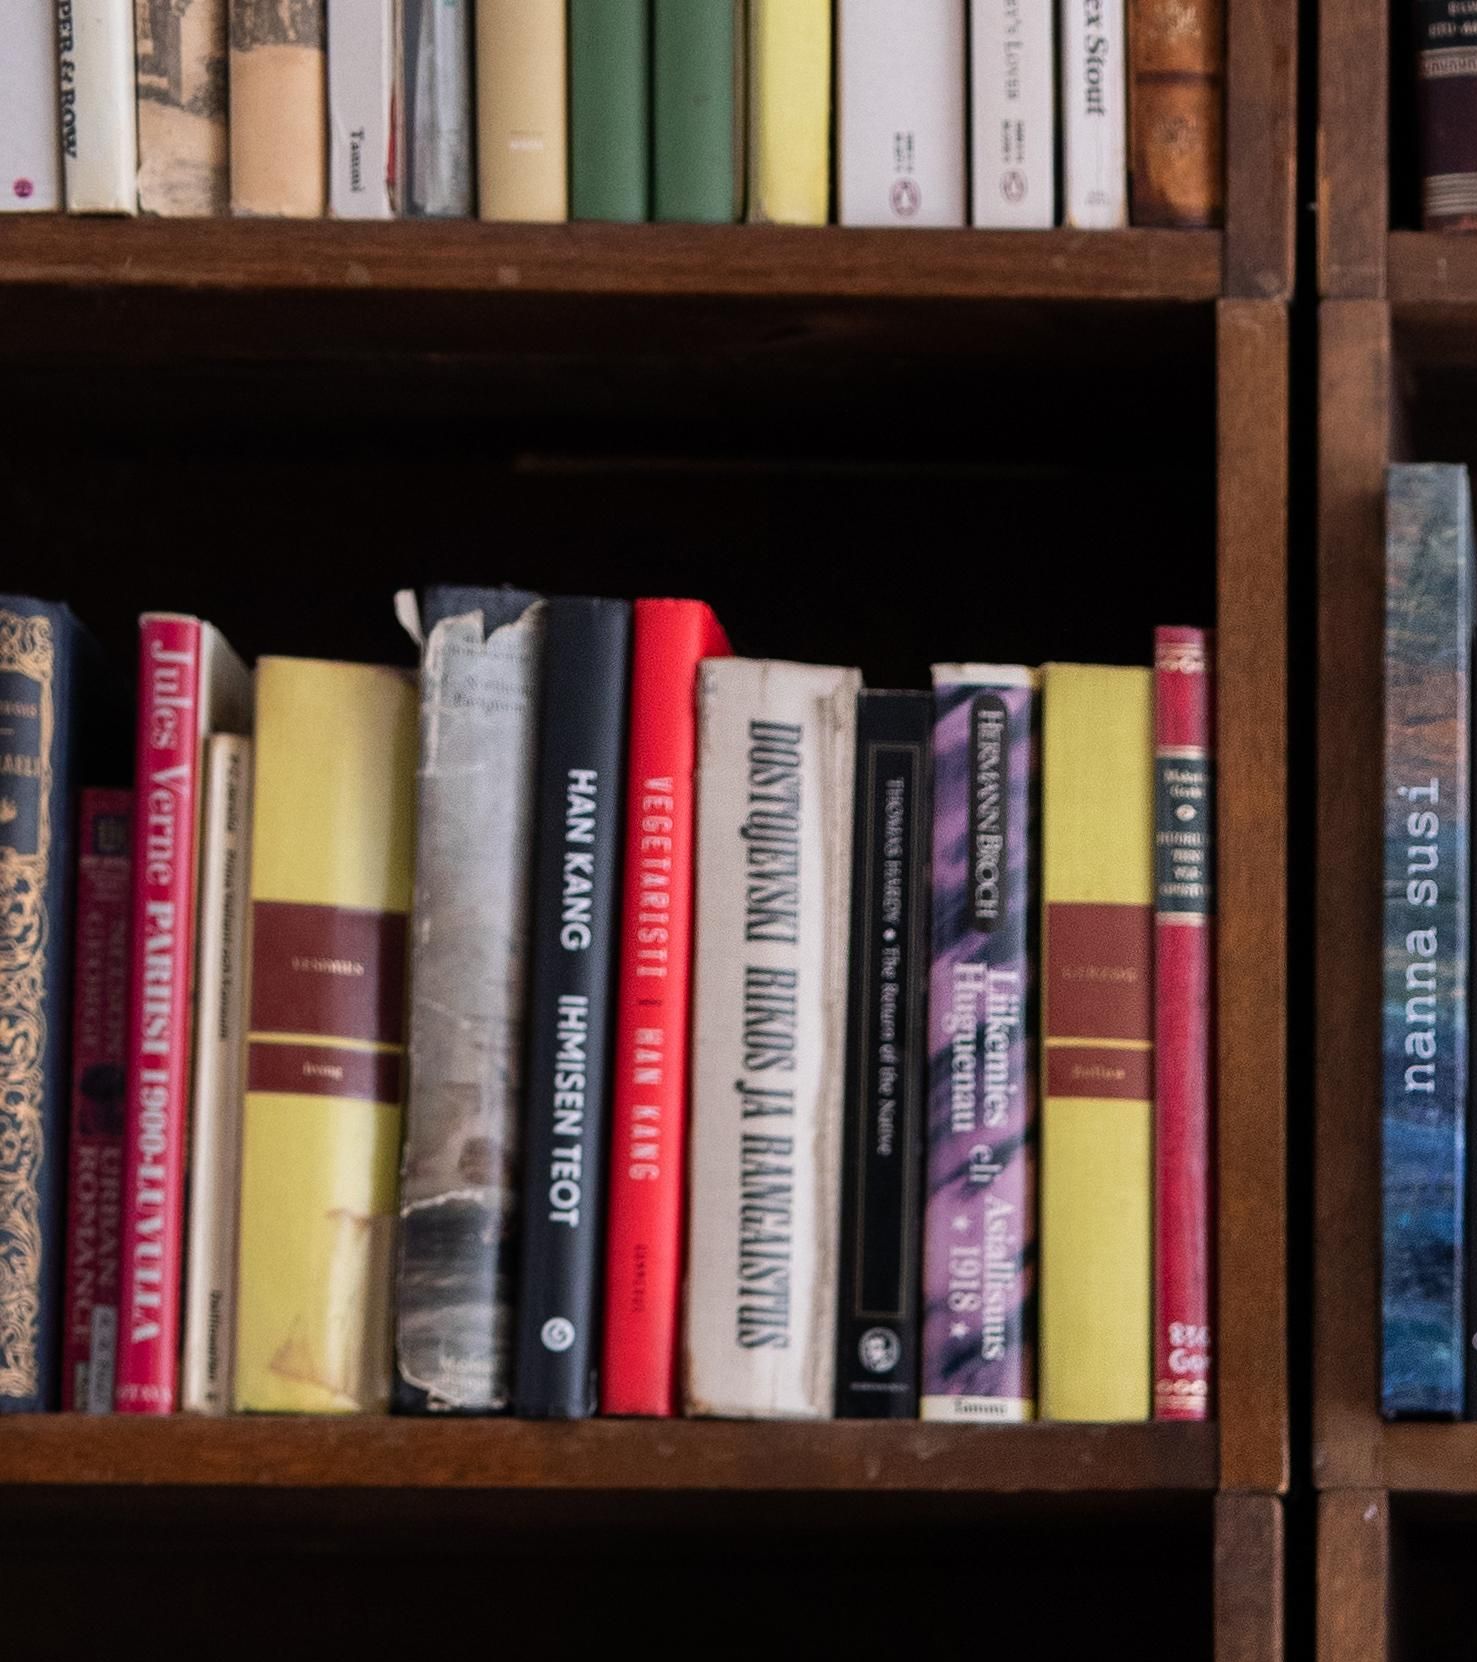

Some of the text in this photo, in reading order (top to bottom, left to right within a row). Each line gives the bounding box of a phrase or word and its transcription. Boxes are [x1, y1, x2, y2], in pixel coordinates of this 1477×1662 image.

[146, 641, 194, 883] Jules Verne
[1400, 777, 1444, 1096] nanna susi
[547, 769, 598, 1228] HAN KANG IHMISEN TEOT
[627, 776, 675, 1183] VEGETARISTI HAN KANG
[743, 964, 800, 1070] RIKOS
[945, 962, 988, 1313] Huguenau 1918
[980, 968, 1020, 1361] Liikemies Asiallisuus
